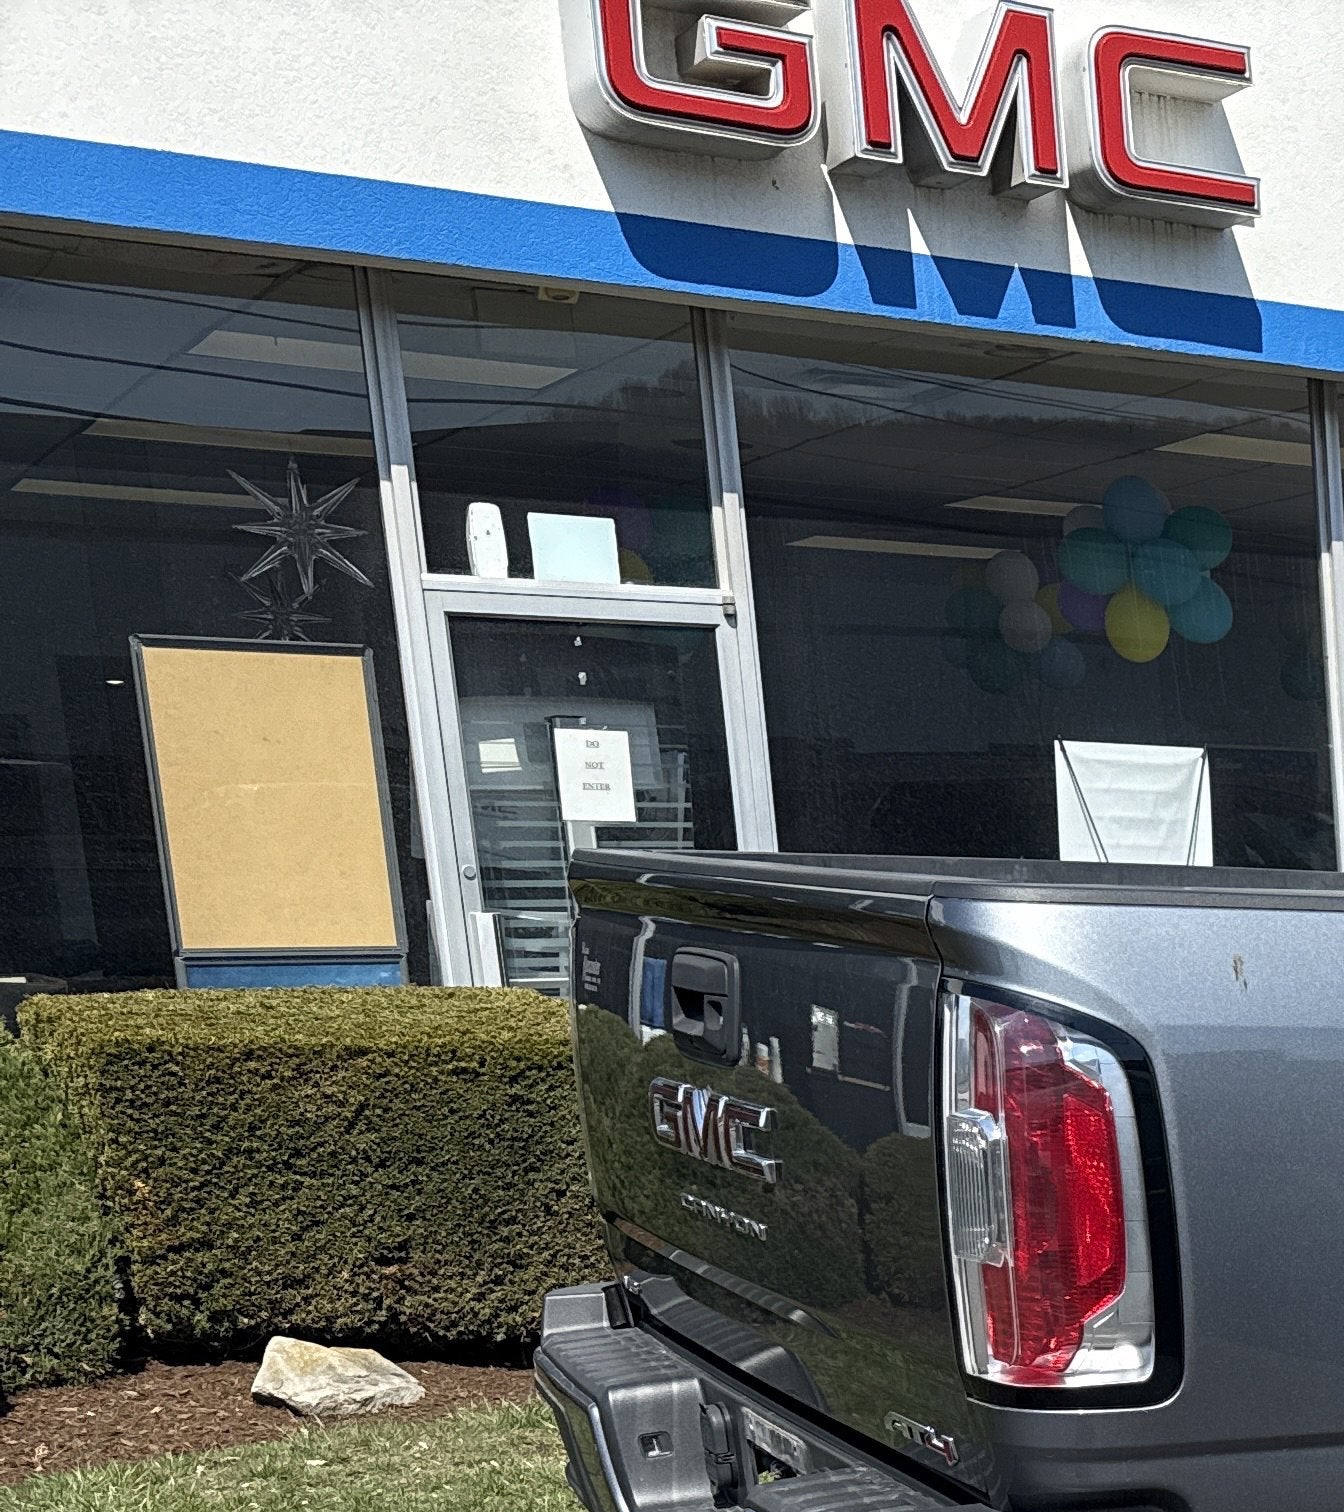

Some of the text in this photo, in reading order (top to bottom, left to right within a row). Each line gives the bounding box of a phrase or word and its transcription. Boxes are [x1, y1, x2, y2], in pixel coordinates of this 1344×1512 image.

[590, 0, 1260, 218] GMC
[584, 762, 605, 770] NOT
[585, 740, 600, 748] DO
[582, 783, 611, 791] ENTER
[648, 1077, 780, 1183] GMC
[680, 1192, 770, 1241] CANYON
[884, 1411, 960, 1467] AT4
